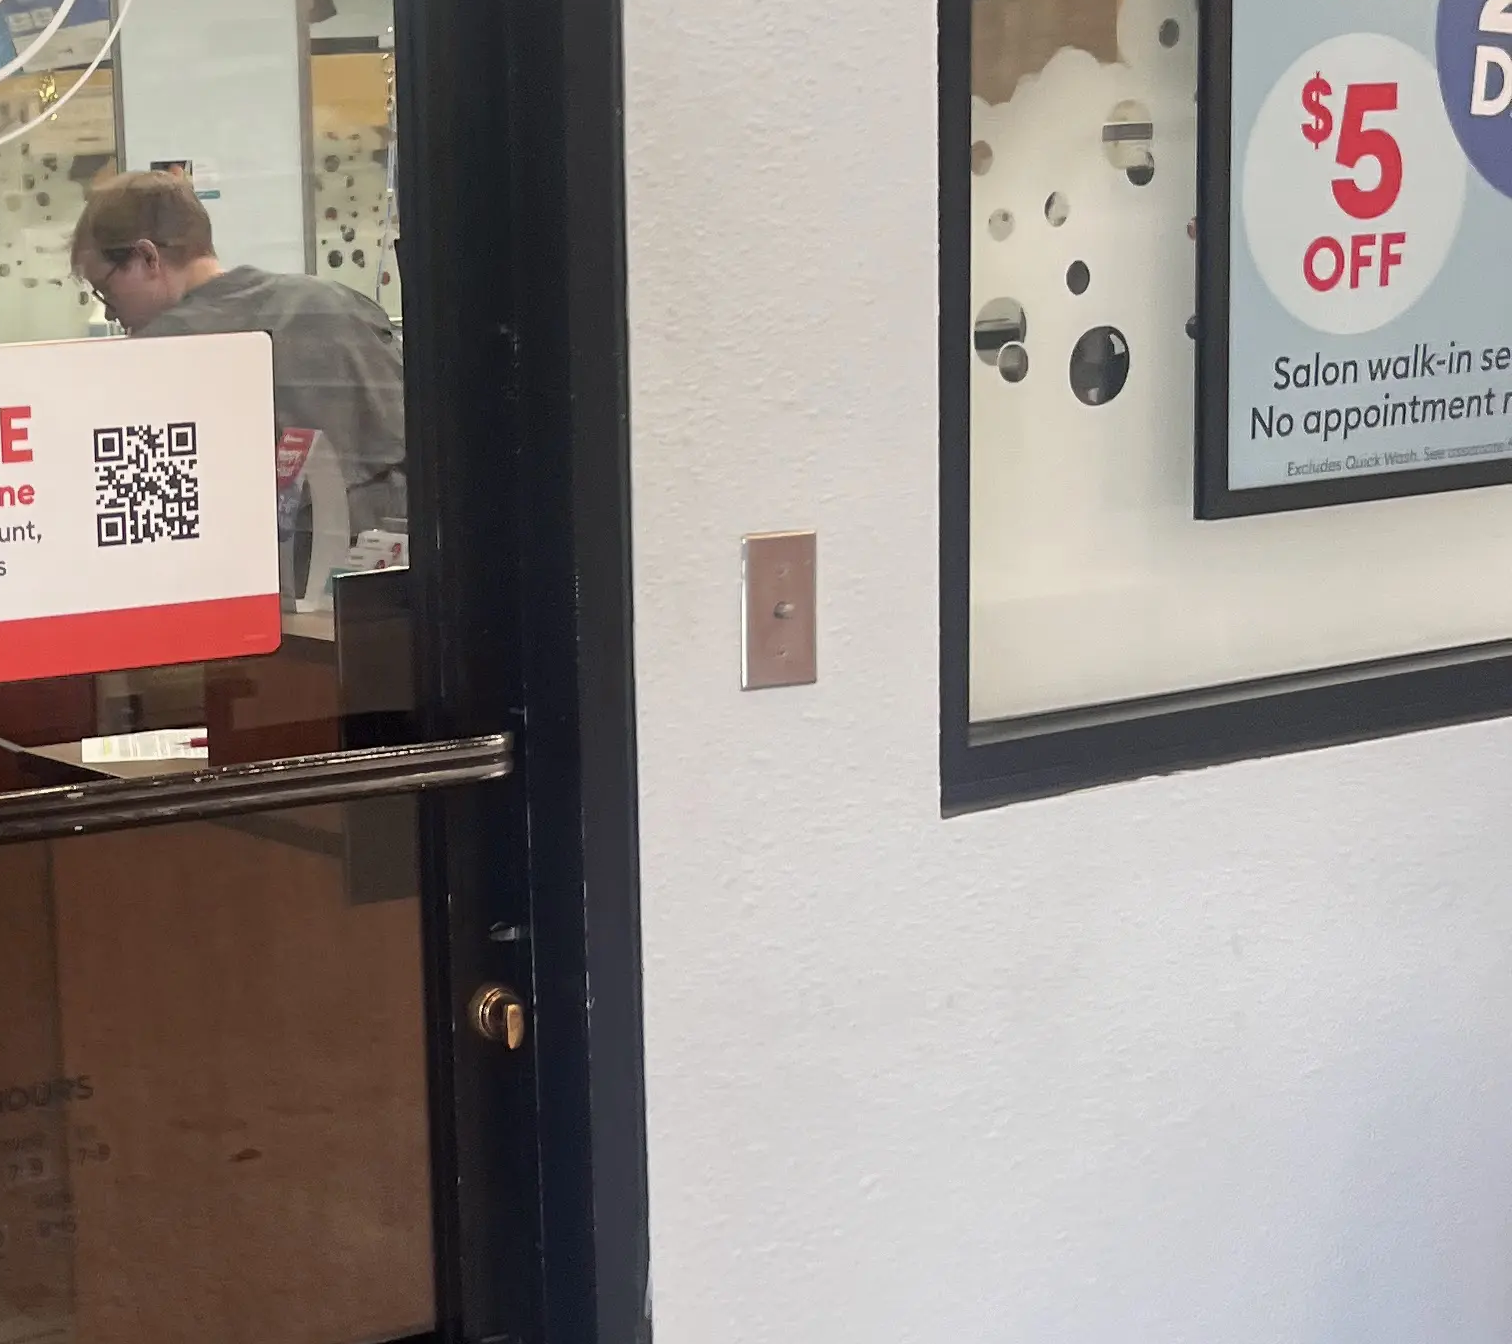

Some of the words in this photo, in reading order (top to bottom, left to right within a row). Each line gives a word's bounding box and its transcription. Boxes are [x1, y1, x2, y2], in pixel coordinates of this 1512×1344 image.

[1300, 70, 1404, 220] $5
[1302, 231, 1407, 293] OFF
[1273, 351, 1359, 391] Salon
[1367, 340, 1472, 382] walk-in
[1250, 405, 1294, 442] No
[1302, 387, 1497, 443] appointment
[1287, 457, 1342, 477] Excludes
